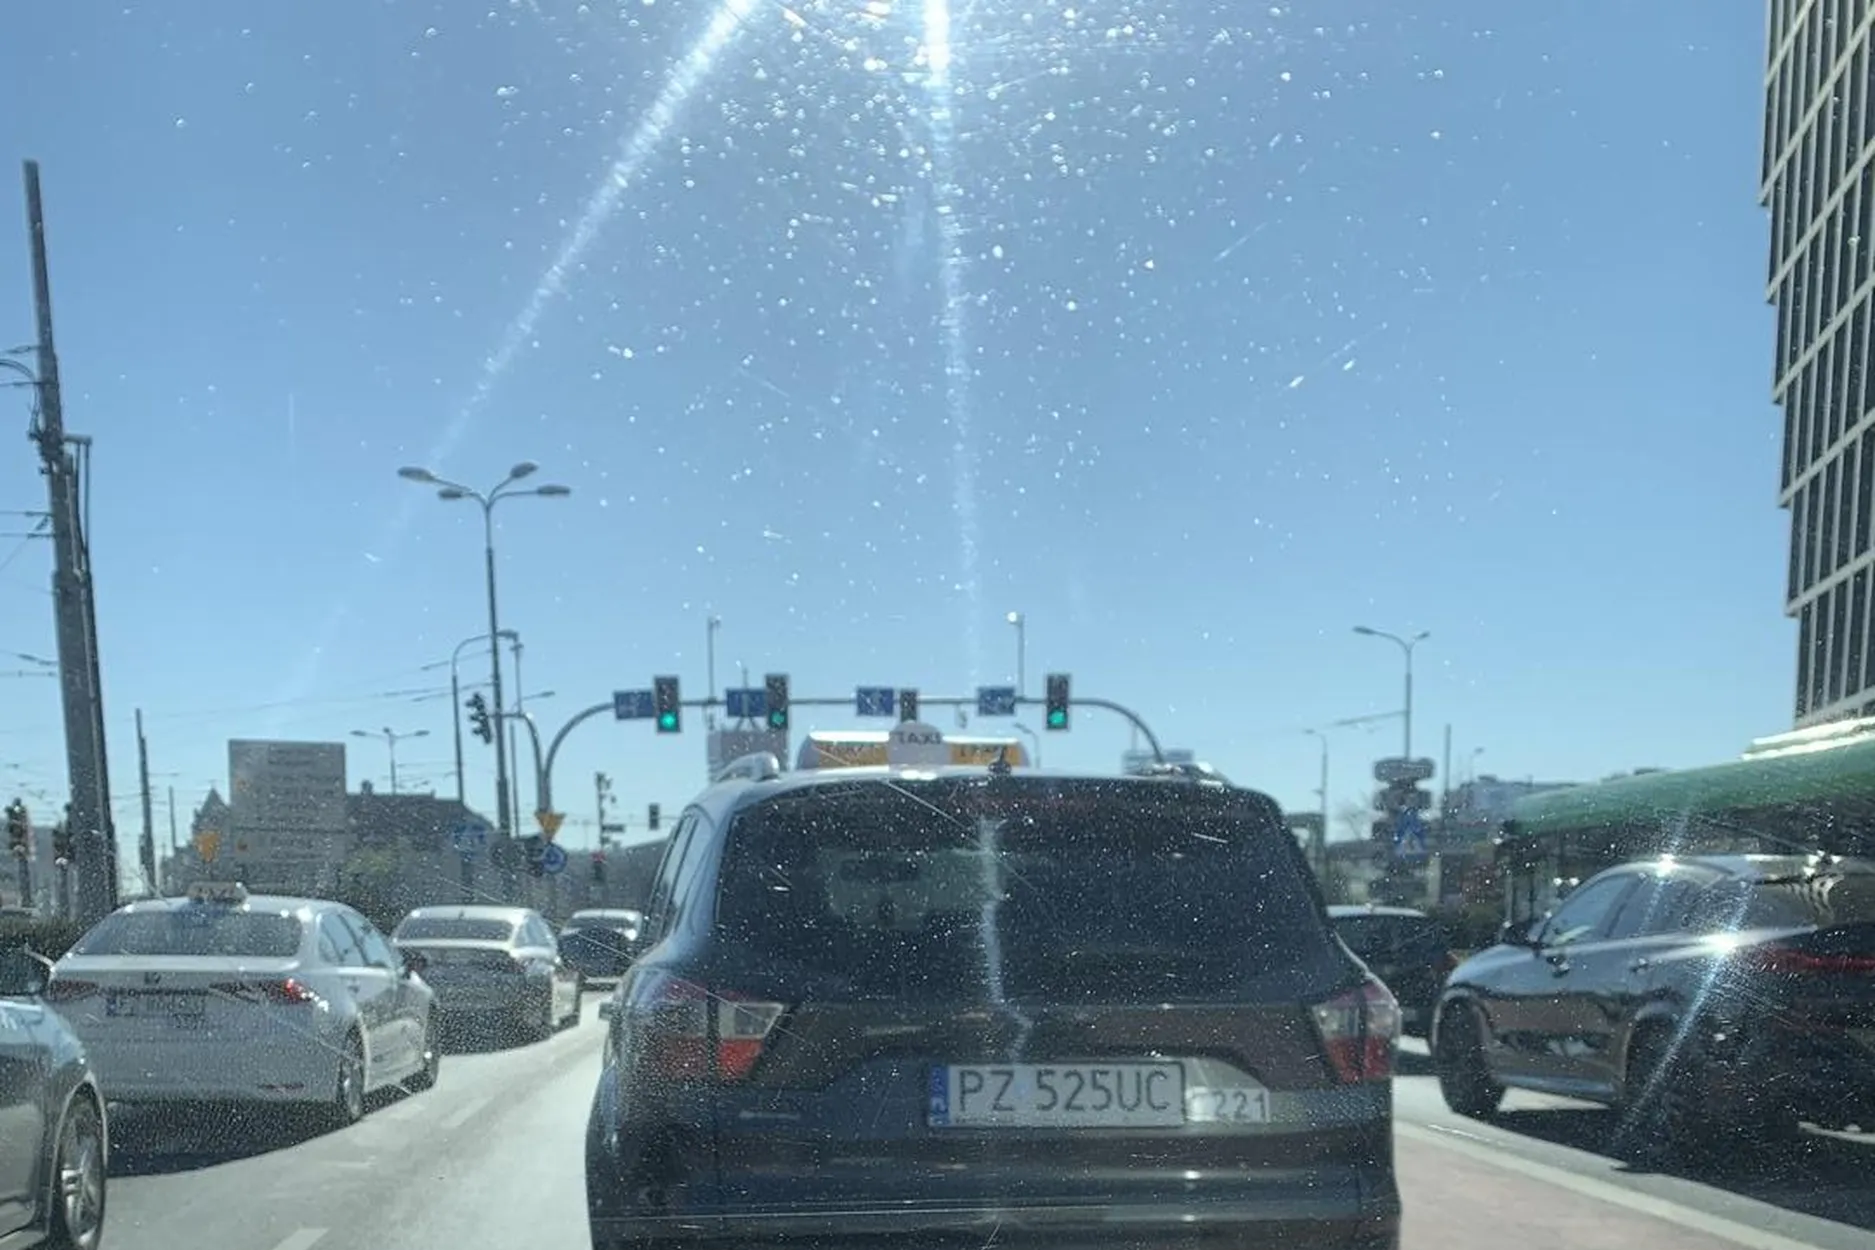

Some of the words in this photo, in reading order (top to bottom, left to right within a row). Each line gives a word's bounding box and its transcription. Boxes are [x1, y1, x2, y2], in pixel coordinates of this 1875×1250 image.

[897, 731, 942, 745] TAXI
[959, 1070, 1015, 1111] PZ
[1035, 1069, 1168, 1111] 525UC
